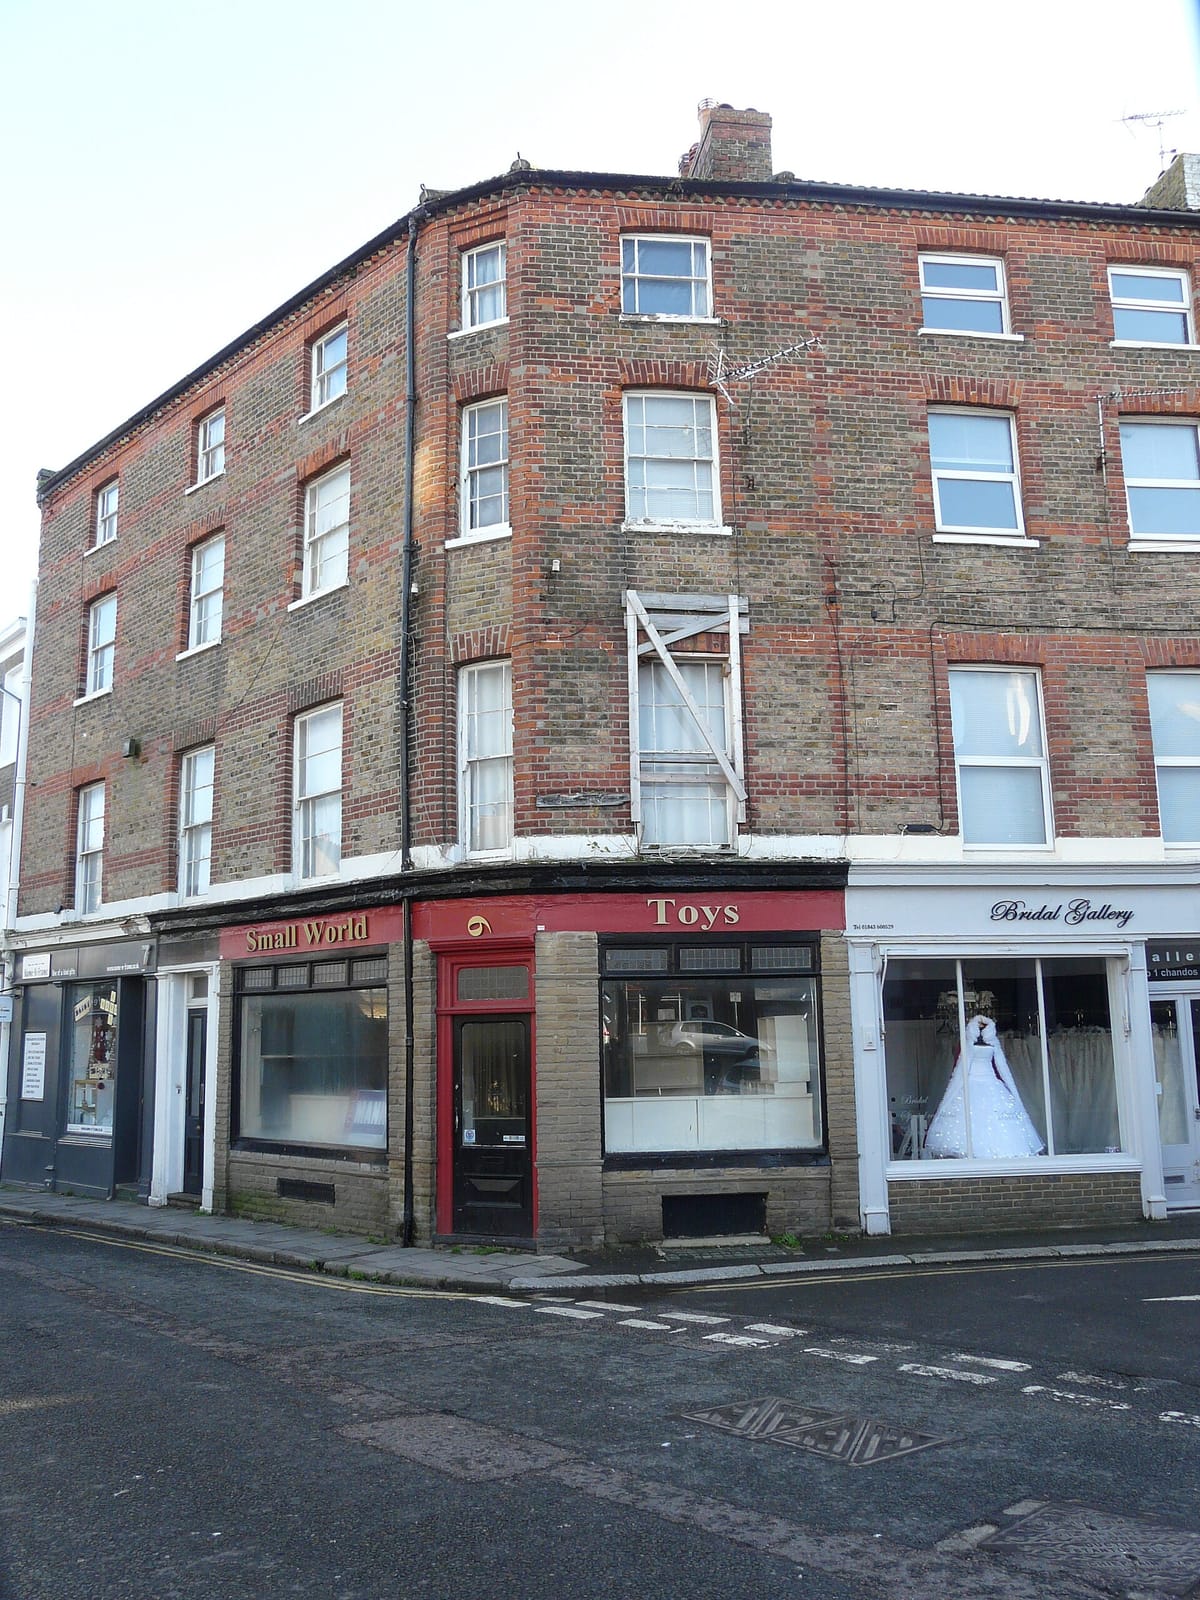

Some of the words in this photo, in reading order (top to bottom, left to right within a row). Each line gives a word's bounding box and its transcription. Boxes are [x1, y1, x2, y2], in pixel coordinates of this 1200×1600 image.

[647, 899, 739, 930] Toys
[990, 900, 1062, 921] Bridal
[1064, 898, 1134, 928] Gallery
[246, 924, 298, 952] Small
[303, 914, 368, 945] World
[141, 944, 151, 966] 7
[1152, 951, 1200, 962] alle
[1153, 968, 1158, 977] 1
[1160, 967, 1199, 977] chandos
